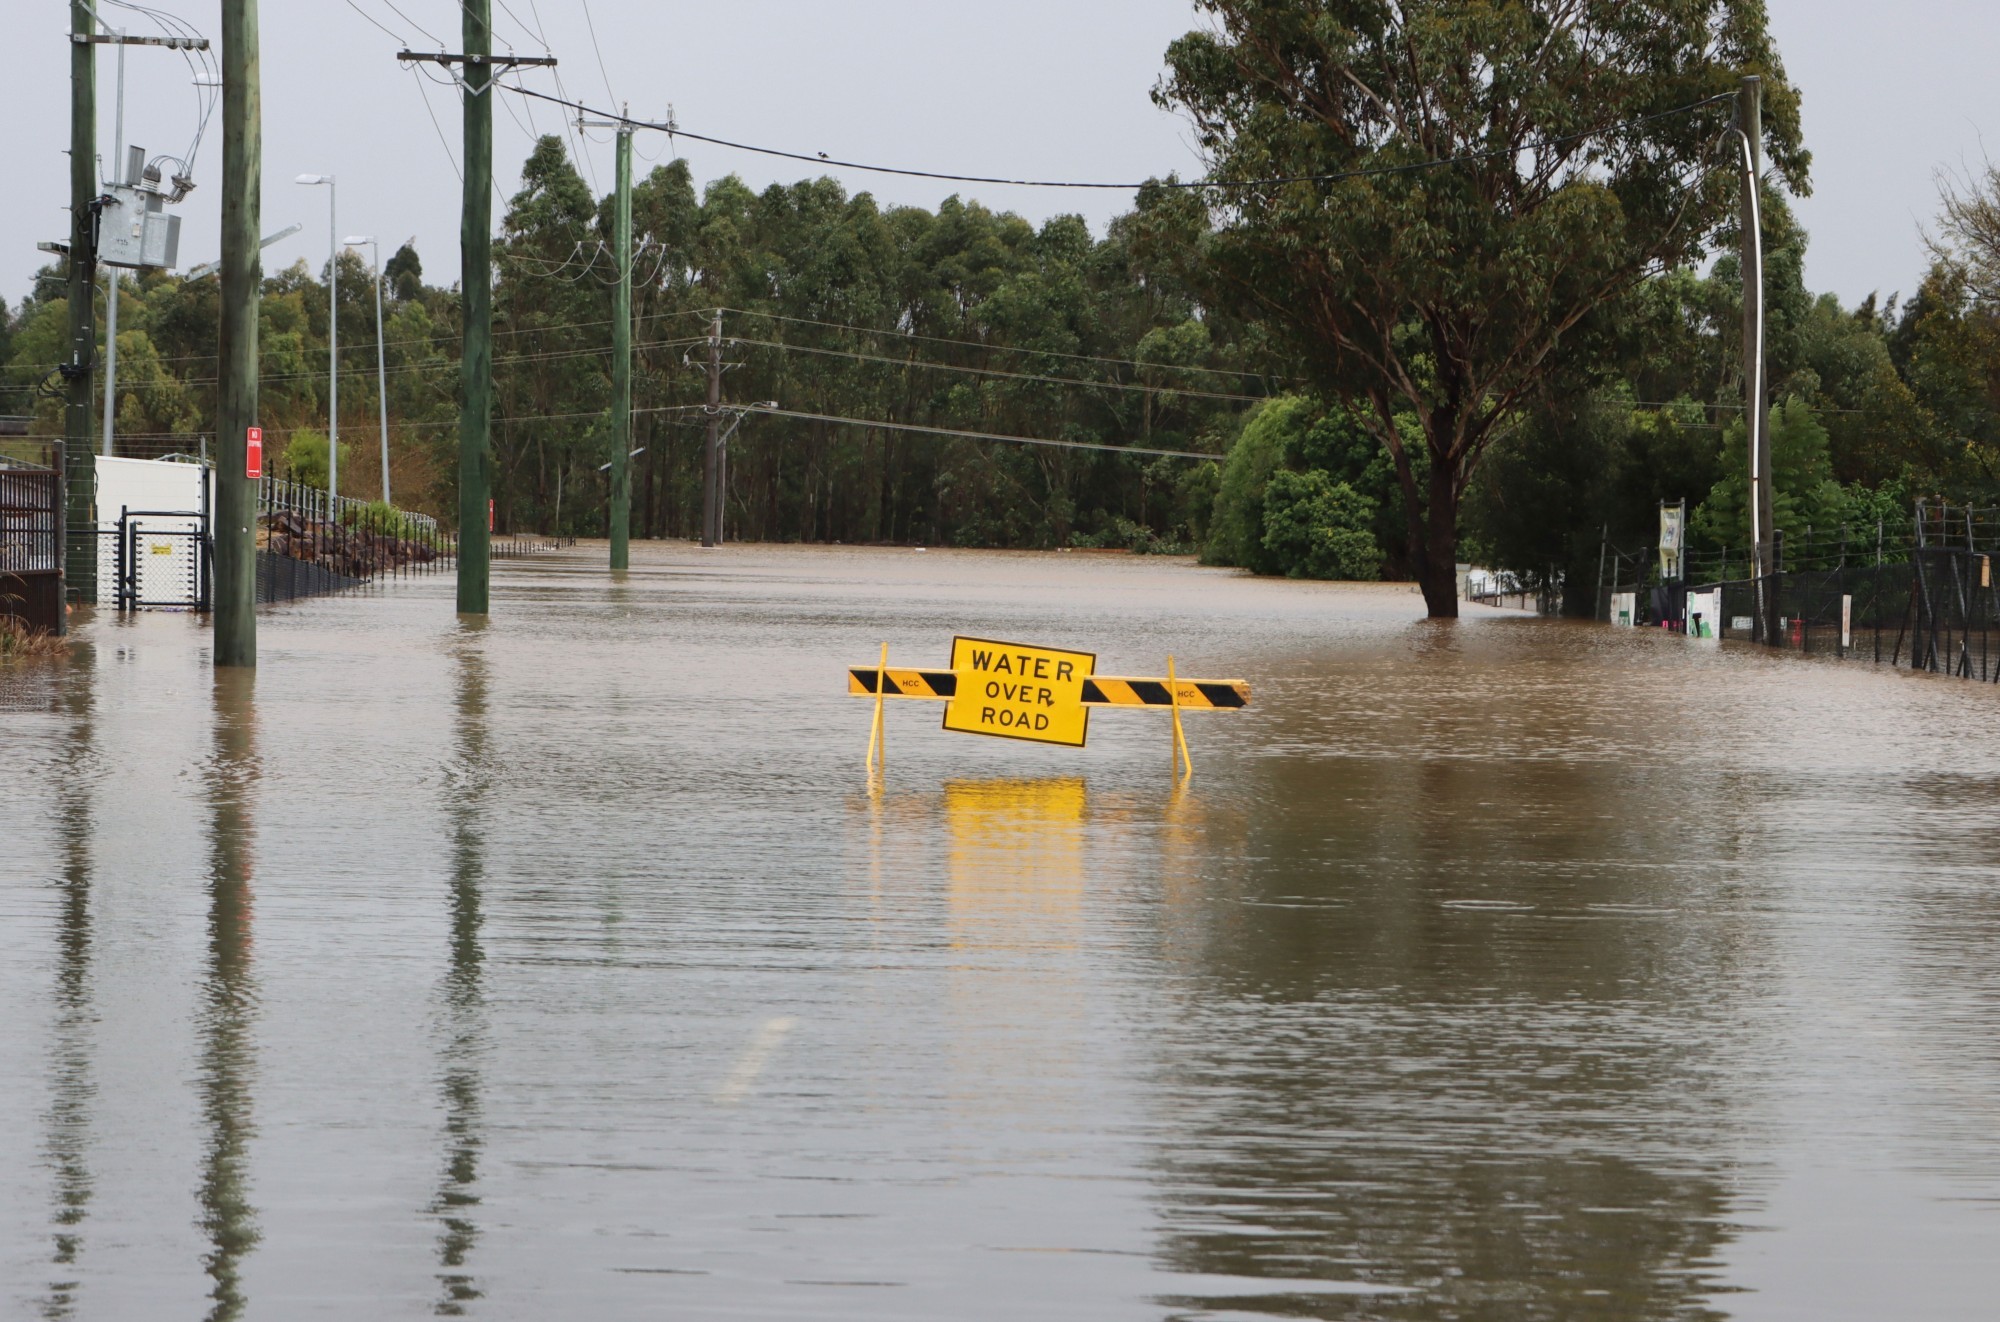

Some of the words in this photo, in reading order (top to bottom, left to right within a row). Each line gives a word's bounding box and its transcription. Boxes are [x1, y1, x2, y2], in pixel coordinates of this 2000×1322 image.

[972, 649, 1074, 682] WATER
[985, 681, 1052, 703] OVER
[1178, 690, 1195, 698] HCC
[981, 707, 1049, 731] ROAD
